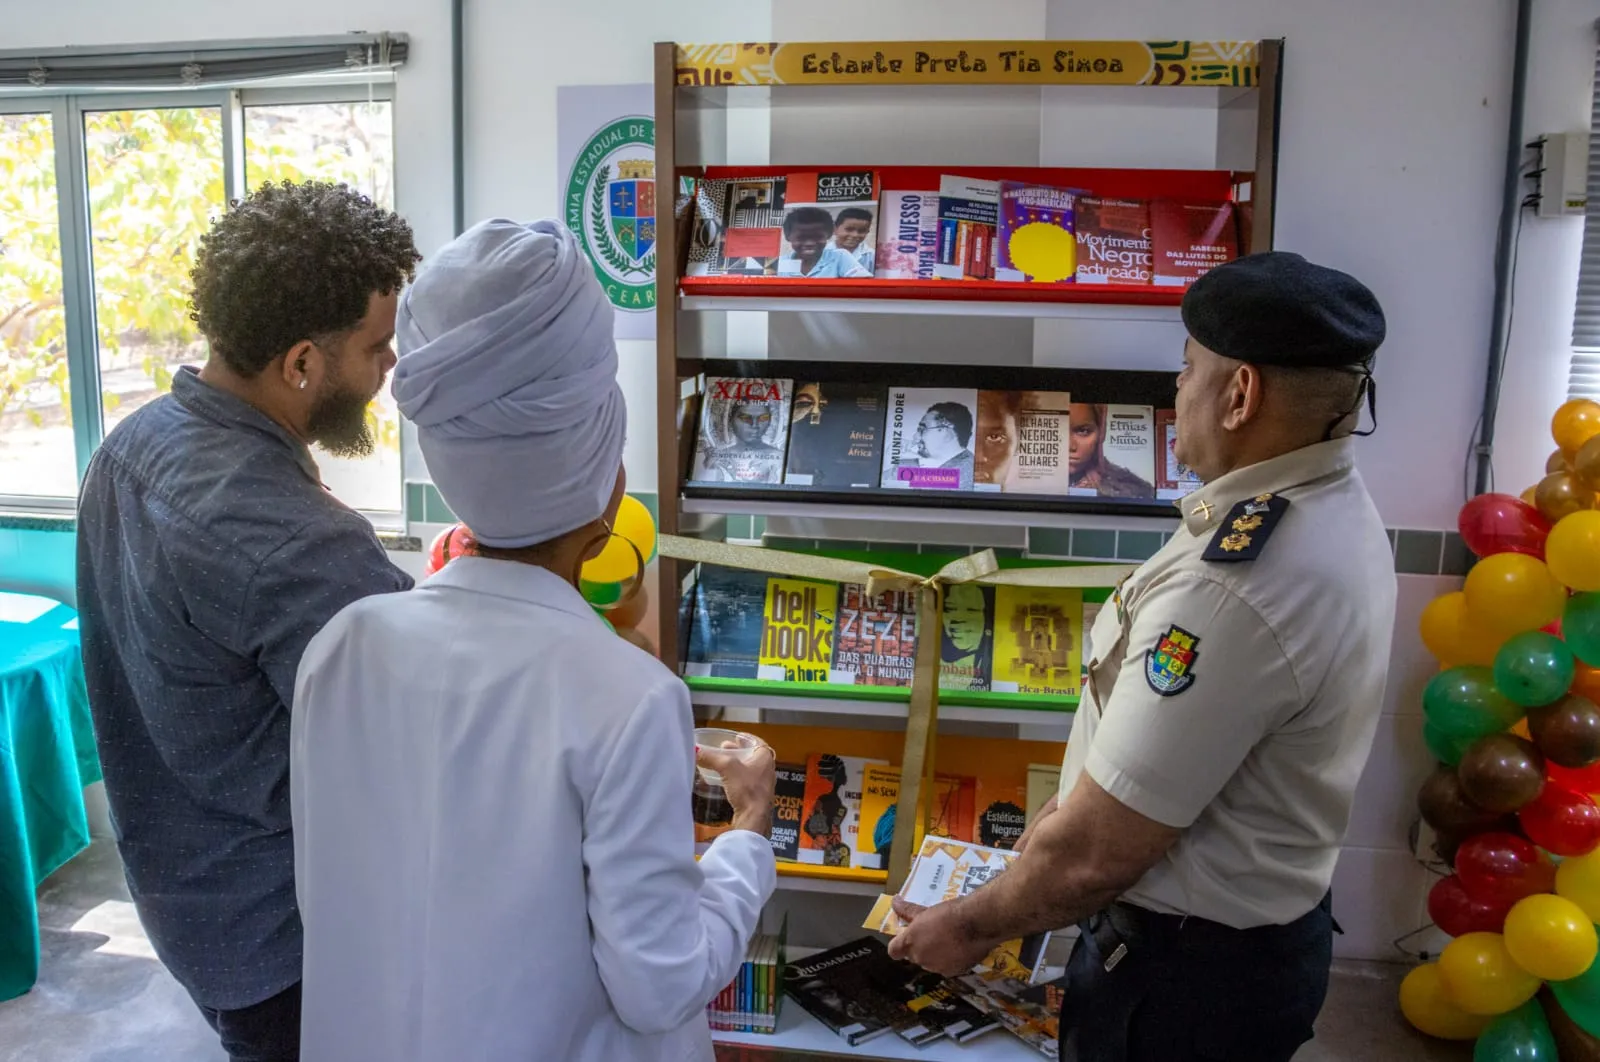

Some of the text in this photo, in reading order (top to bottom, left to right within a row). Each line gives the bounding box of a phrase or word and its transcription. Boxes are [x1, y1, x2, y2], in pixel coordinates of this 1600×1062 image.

[802, 50, 1124, 74] Estante Preta Tia Simoa
[575, 129, 625, 186] ESTADUAL
[629, 124, 645, 139] DE
[818, 173, 871, 188] CEARÁ
[818, 186, 872, 198] MESTIÇO
[897, 195, 921, 254] O AVESSO
[1185, 252, 1212, 260] LUTAS
[1190, 244, 1227, 253] SABERES
[1076, 263, 1152, 281] educado
[712, 381, 782, 401] XICA
[891, 393, 905, 465] MUNIZ SODRÉ
[1020, 416, 1060, 428] OLHARES
[1109, 420, 1148, 432] Etnias
[849, 430, 874, 441] África
[1109, 435, 1148, 445] Mundo
[847, 448, 872, 458] África
[1019, 442, 1059, 455] NEGROS
[1018, 455, 1059, 467] OLHARES
[772, 583, 817, 627] bell
[838, 651, 914, 669] DAS QUADRAS
[798, 665, 827, 682] hora
[866, 665, 874, 677] O
[878, 666, 914, 680] MUNDO
[987, 810, 1025, 824] Estéticas
[991, 822, 1023, 837] Negras
